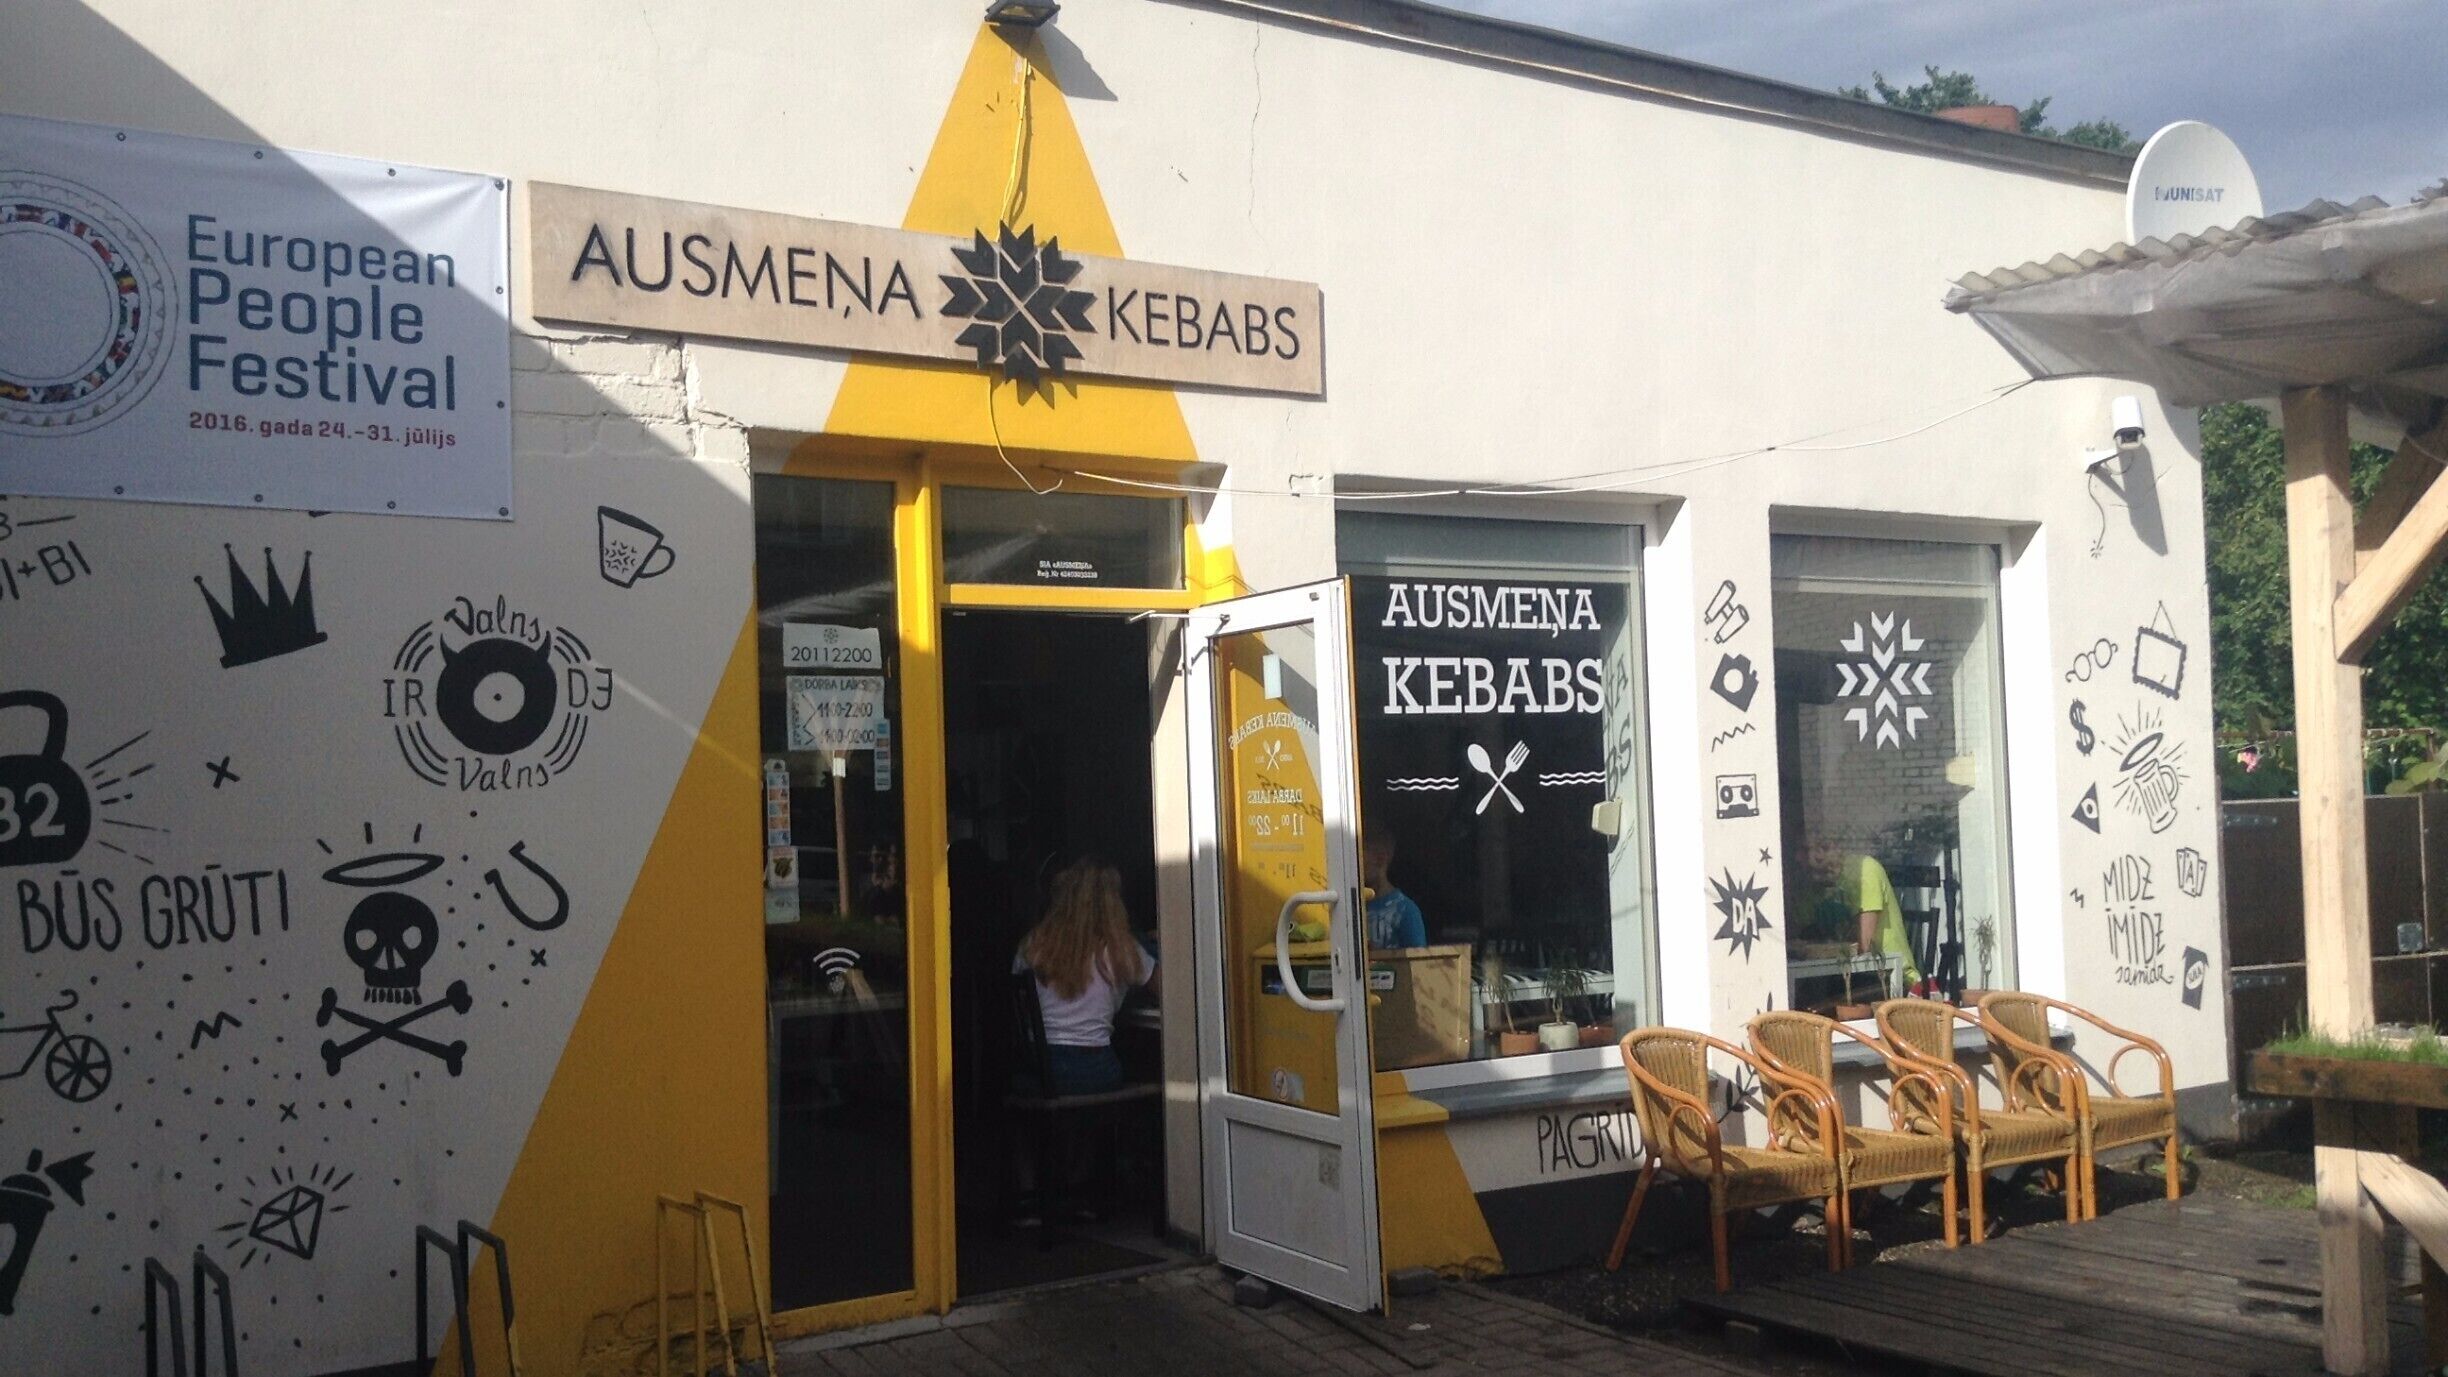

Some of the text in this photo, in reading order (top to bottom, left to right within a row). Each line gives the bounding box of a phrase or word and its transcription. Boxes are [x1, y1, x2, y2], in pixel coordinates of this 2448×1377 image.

[188, 214, 455, 288] European
[189, 267, 423, 353] People
[571, 222, 1301, 361] AUSMEŅA KEBABS
[189, 333, 456, 411] Festival
[189, 411, 254, 433] 2016.
[260, 418, 313, 438] gada
[404, 426, 457, 450] jūlijs
[1382, 583, 1602, 638] AUSMEŅA
[791, 646, 872, 664] 20112200
[383, 679, 427, 718] IR
[1382, 656, 1606, 714] KEBABS
[454, 757, 549, 791] Valns
[17, 863, 289, 953] BŪS GRŪTI
